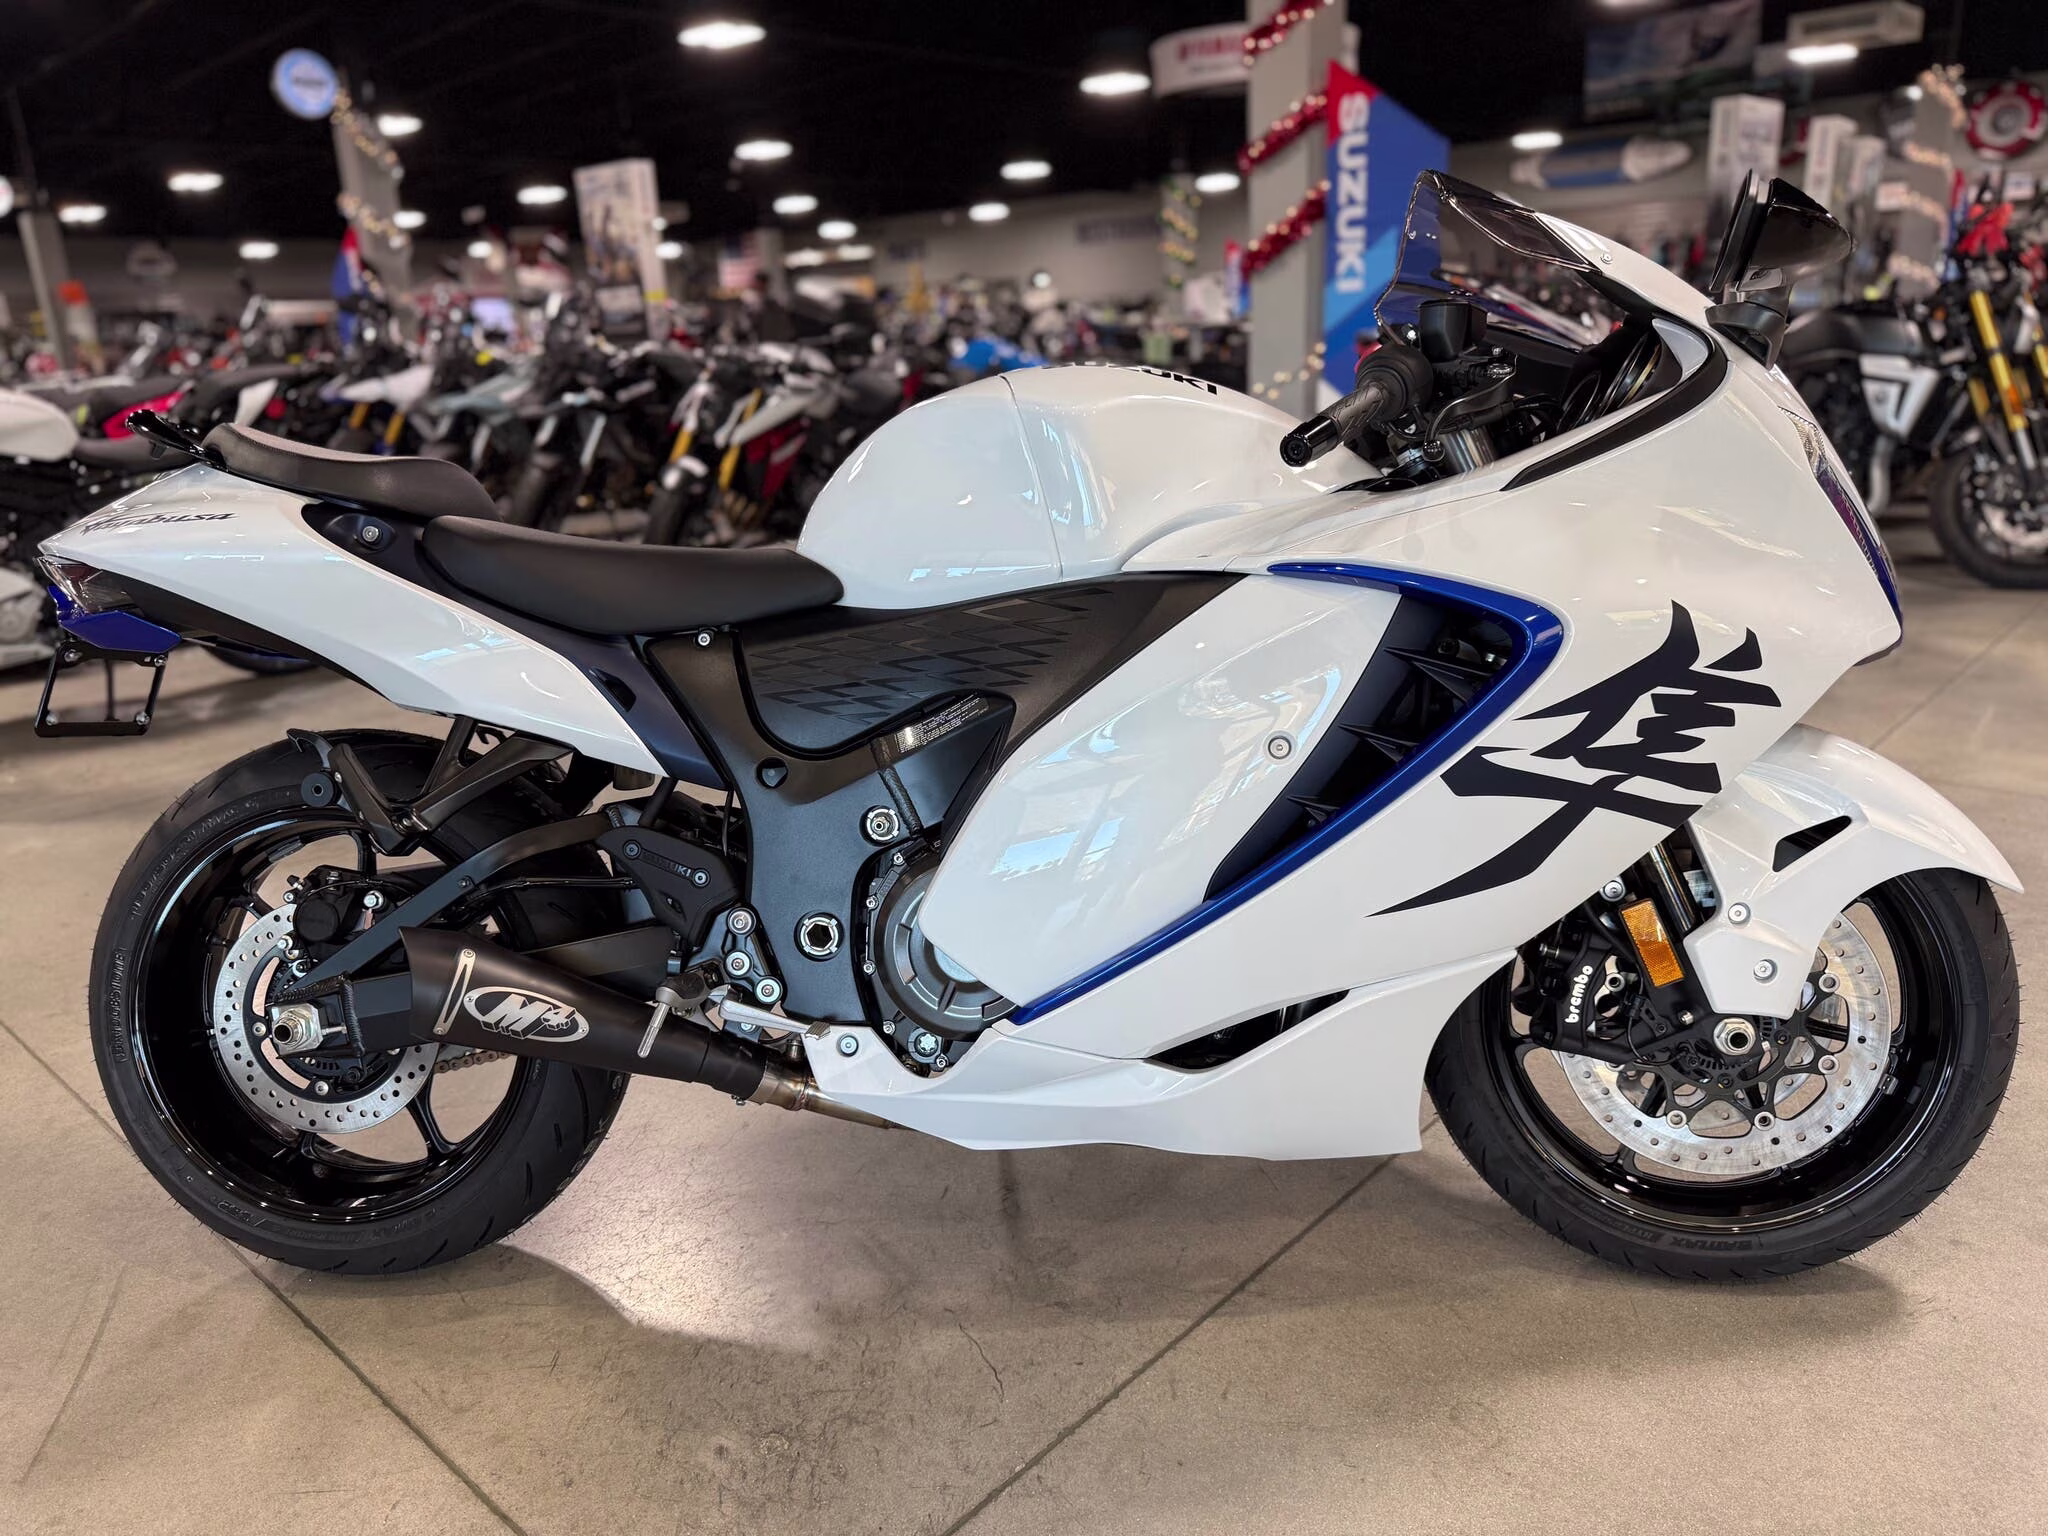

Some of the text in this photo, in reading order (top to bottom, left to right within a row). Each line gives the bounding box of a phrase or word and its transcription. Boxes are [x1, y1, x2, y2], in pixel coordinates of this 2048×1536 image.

[1336, 91, 1370, 294] SUZUKI
[80, 512, 236, 537] Hayabusa
[641, 850, 692, 878] SUZUKI
[480, 993, 577, 1040] M4
[1564, 965, 1594, 1024] brembo
